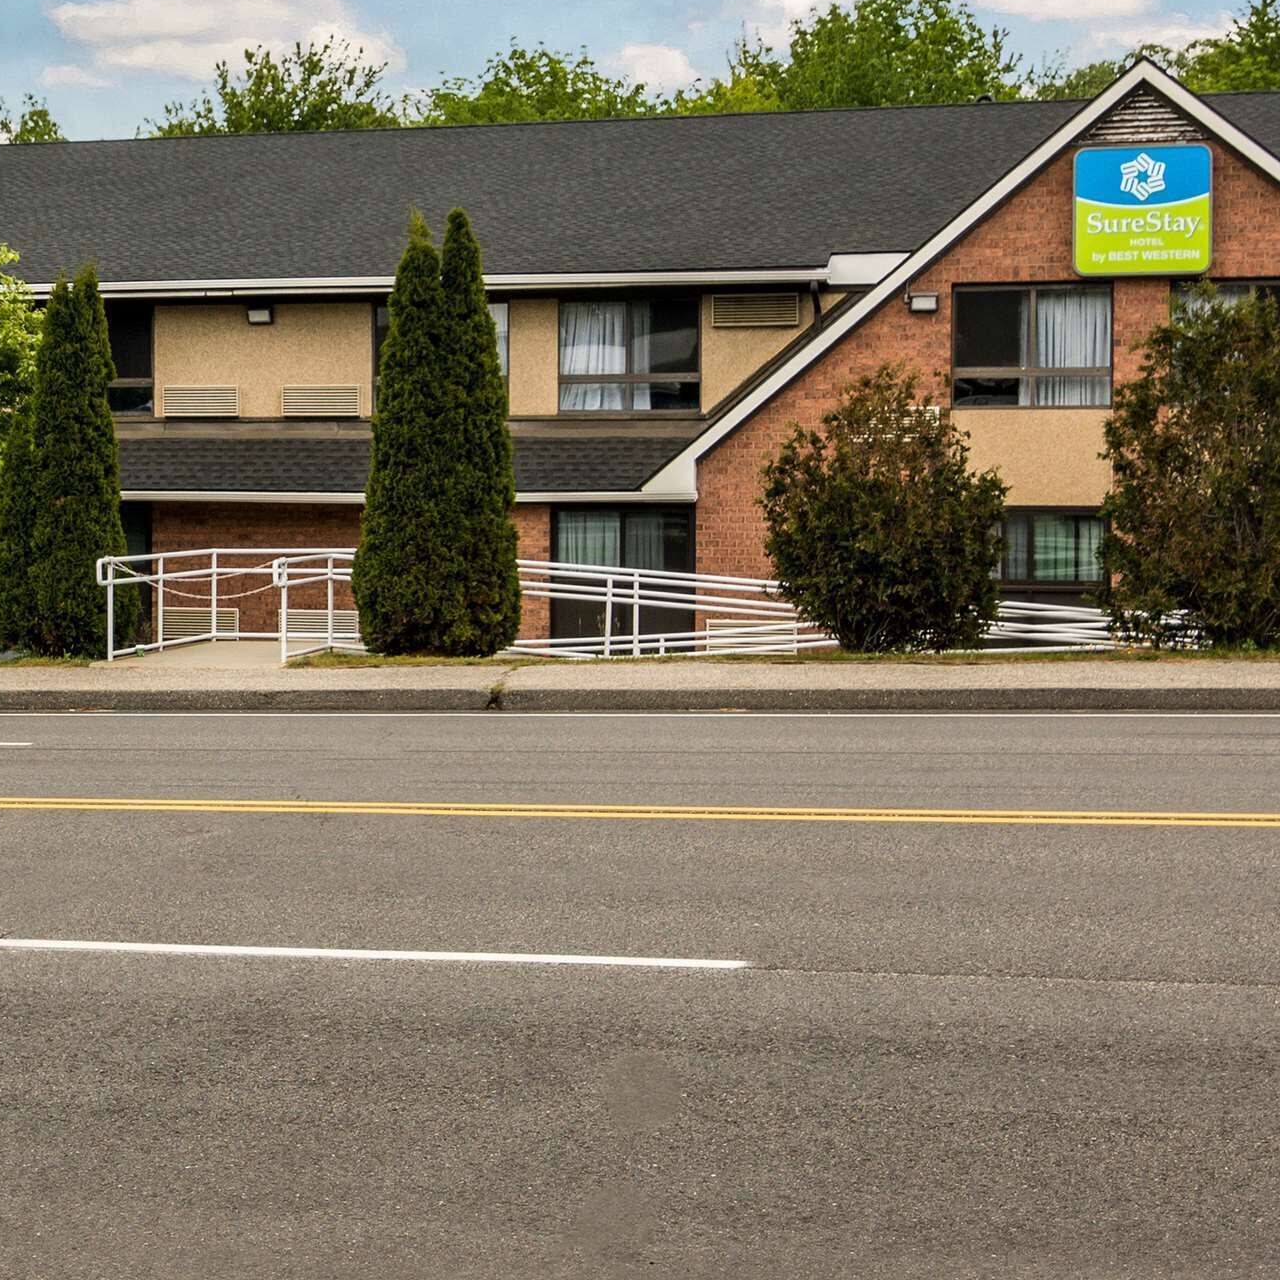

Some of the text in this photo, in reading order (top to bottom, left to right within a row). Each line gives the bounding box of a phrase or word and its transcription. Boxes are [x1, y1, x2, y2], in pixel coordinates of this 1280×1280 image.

[1087, 211, 1201, 238] SureStay
[1130, 238, 1164, 247] HOTEL
[1092, 249, 1200, 264] by BEST WESTERN
